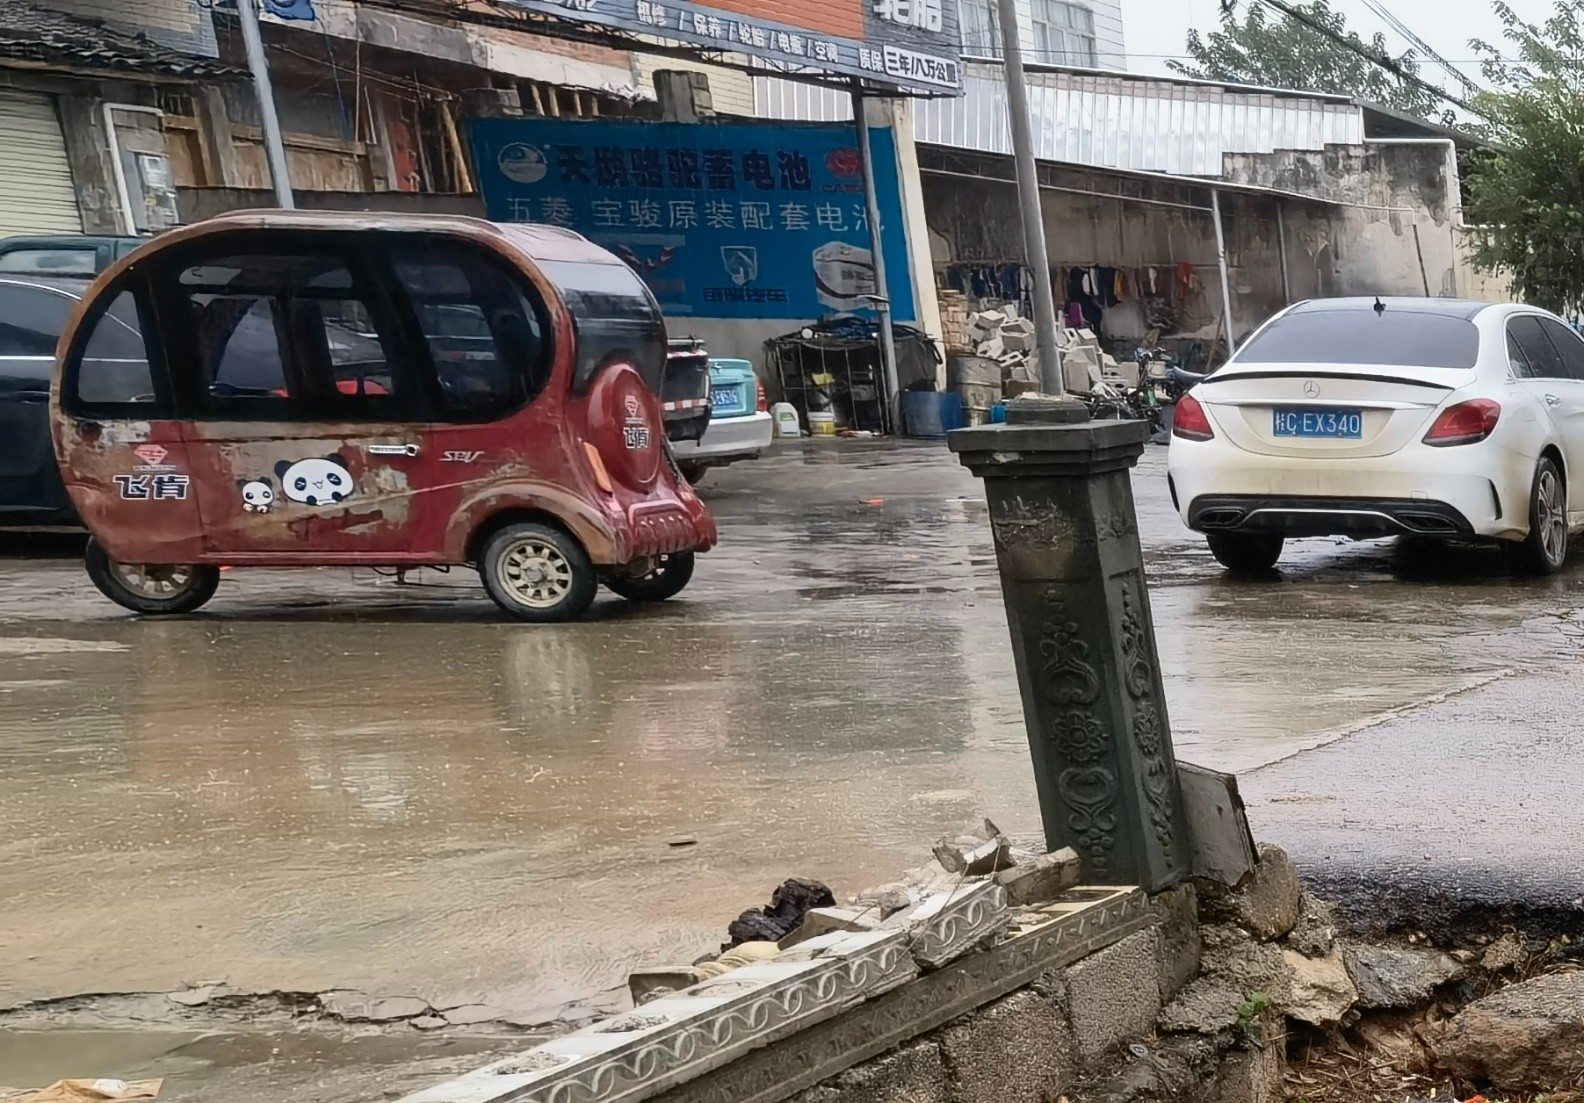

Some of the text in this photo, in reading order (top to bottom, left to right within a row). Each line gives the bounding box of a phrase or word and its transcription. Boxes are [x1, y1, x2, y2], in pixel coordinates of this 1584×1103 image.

[693, 13, 722, 39] 保养
[738, 23, 765, 48] 轮胎
[778, 32, 804, 56] 电瓶
[815, 41, 839, 63] 空调
[858, 48, 885, 72] 质保
[623, 426, 650, 449] 飞肯
[112, 474, 190, 500] 飞肯
